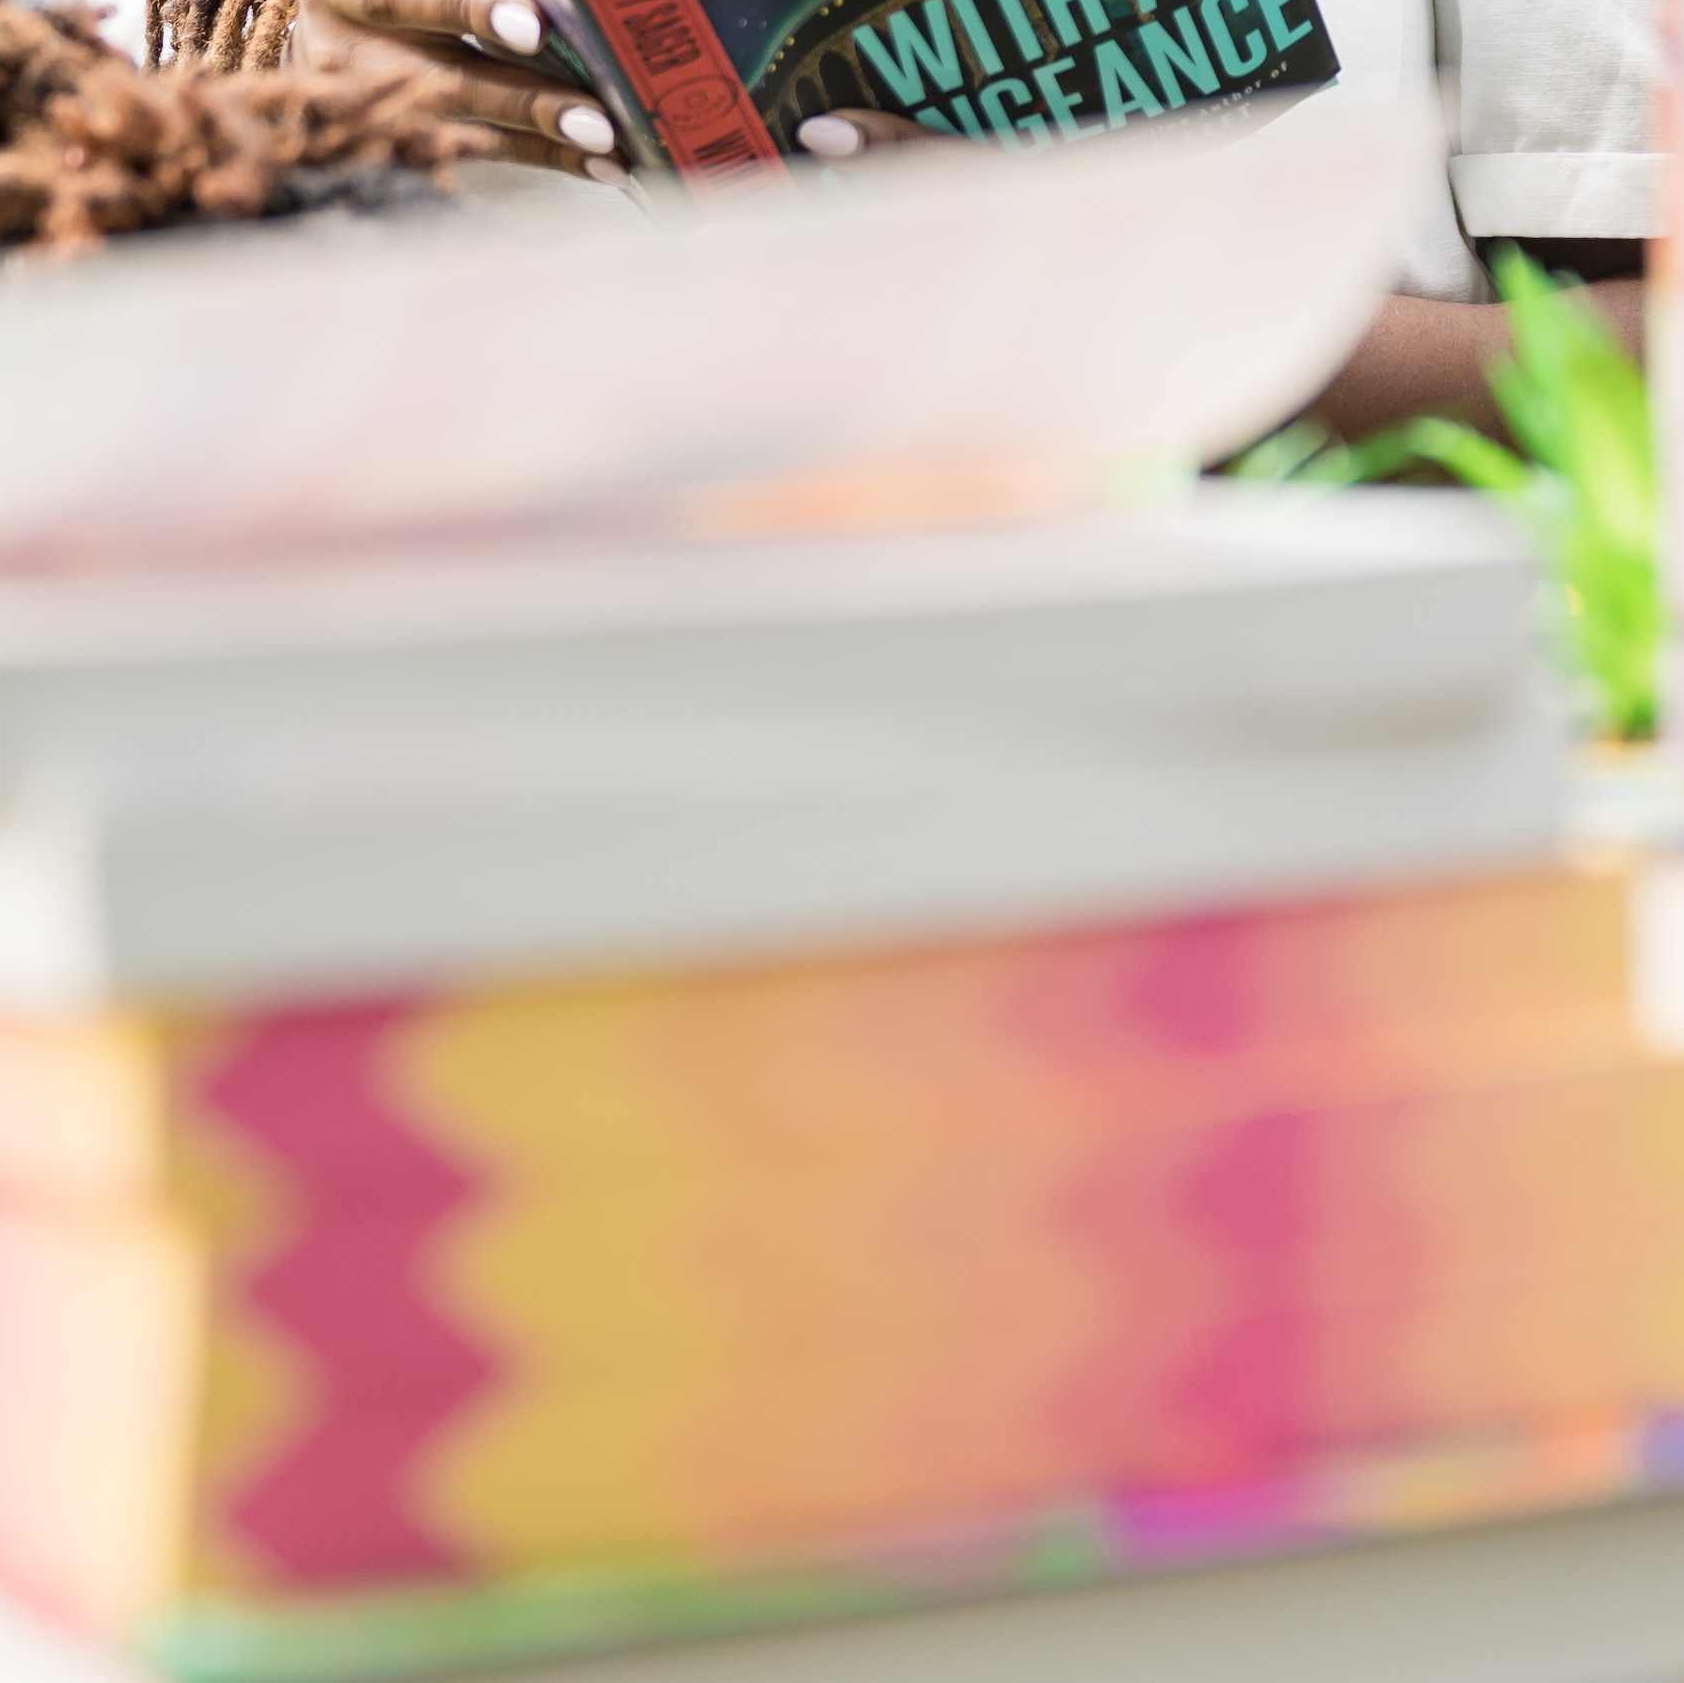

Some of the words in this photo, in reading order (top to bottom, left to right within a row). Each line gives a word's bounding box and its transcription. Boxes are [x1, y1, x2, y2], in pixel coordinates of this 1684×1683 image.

[621, 1, 702, 78] SAGER
[1197, 78, 1264, 118] Author
[1269, 59, 1290, 80] of
